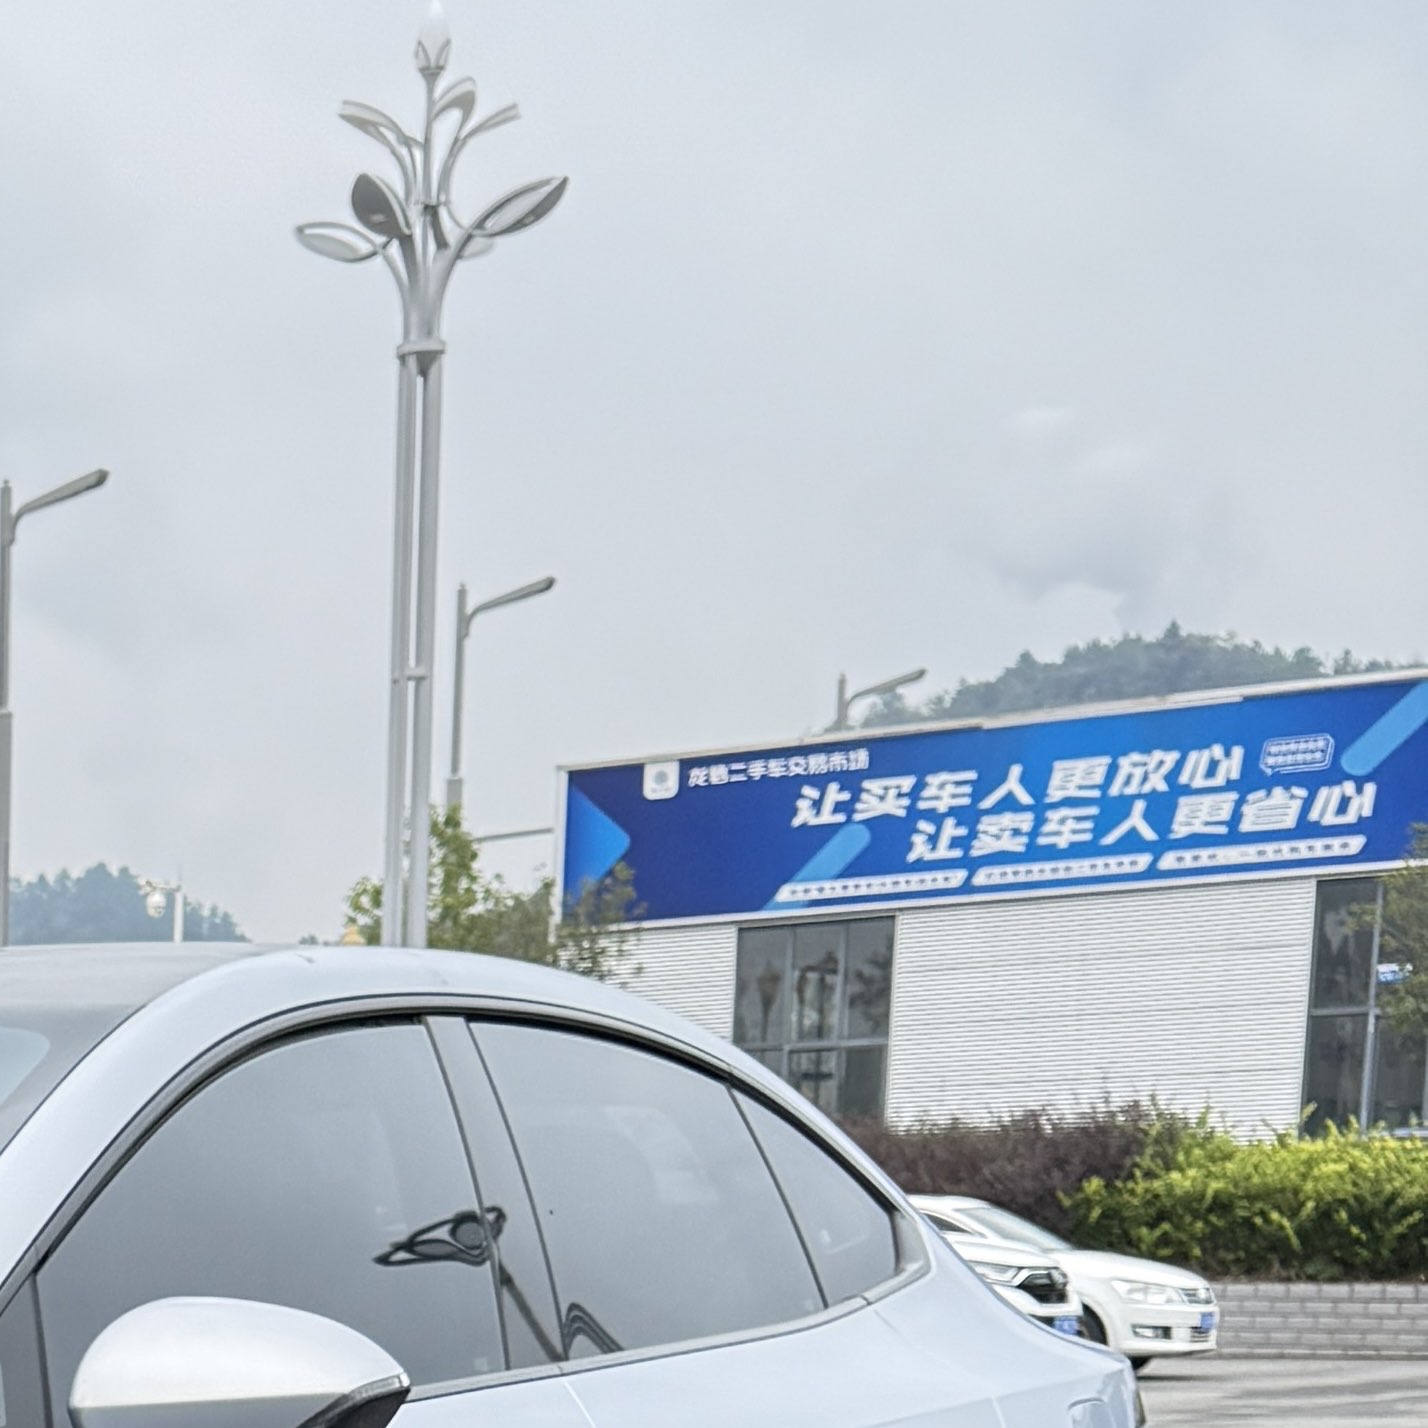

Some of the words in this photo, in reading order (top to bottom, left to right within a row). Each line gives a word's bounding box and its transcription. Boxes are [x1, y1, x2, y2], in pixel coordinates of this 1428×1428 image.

[791, 744, 1244, 828] 让买车人更放心
[906, 780, 1376, 863] 让卖车人更省心
